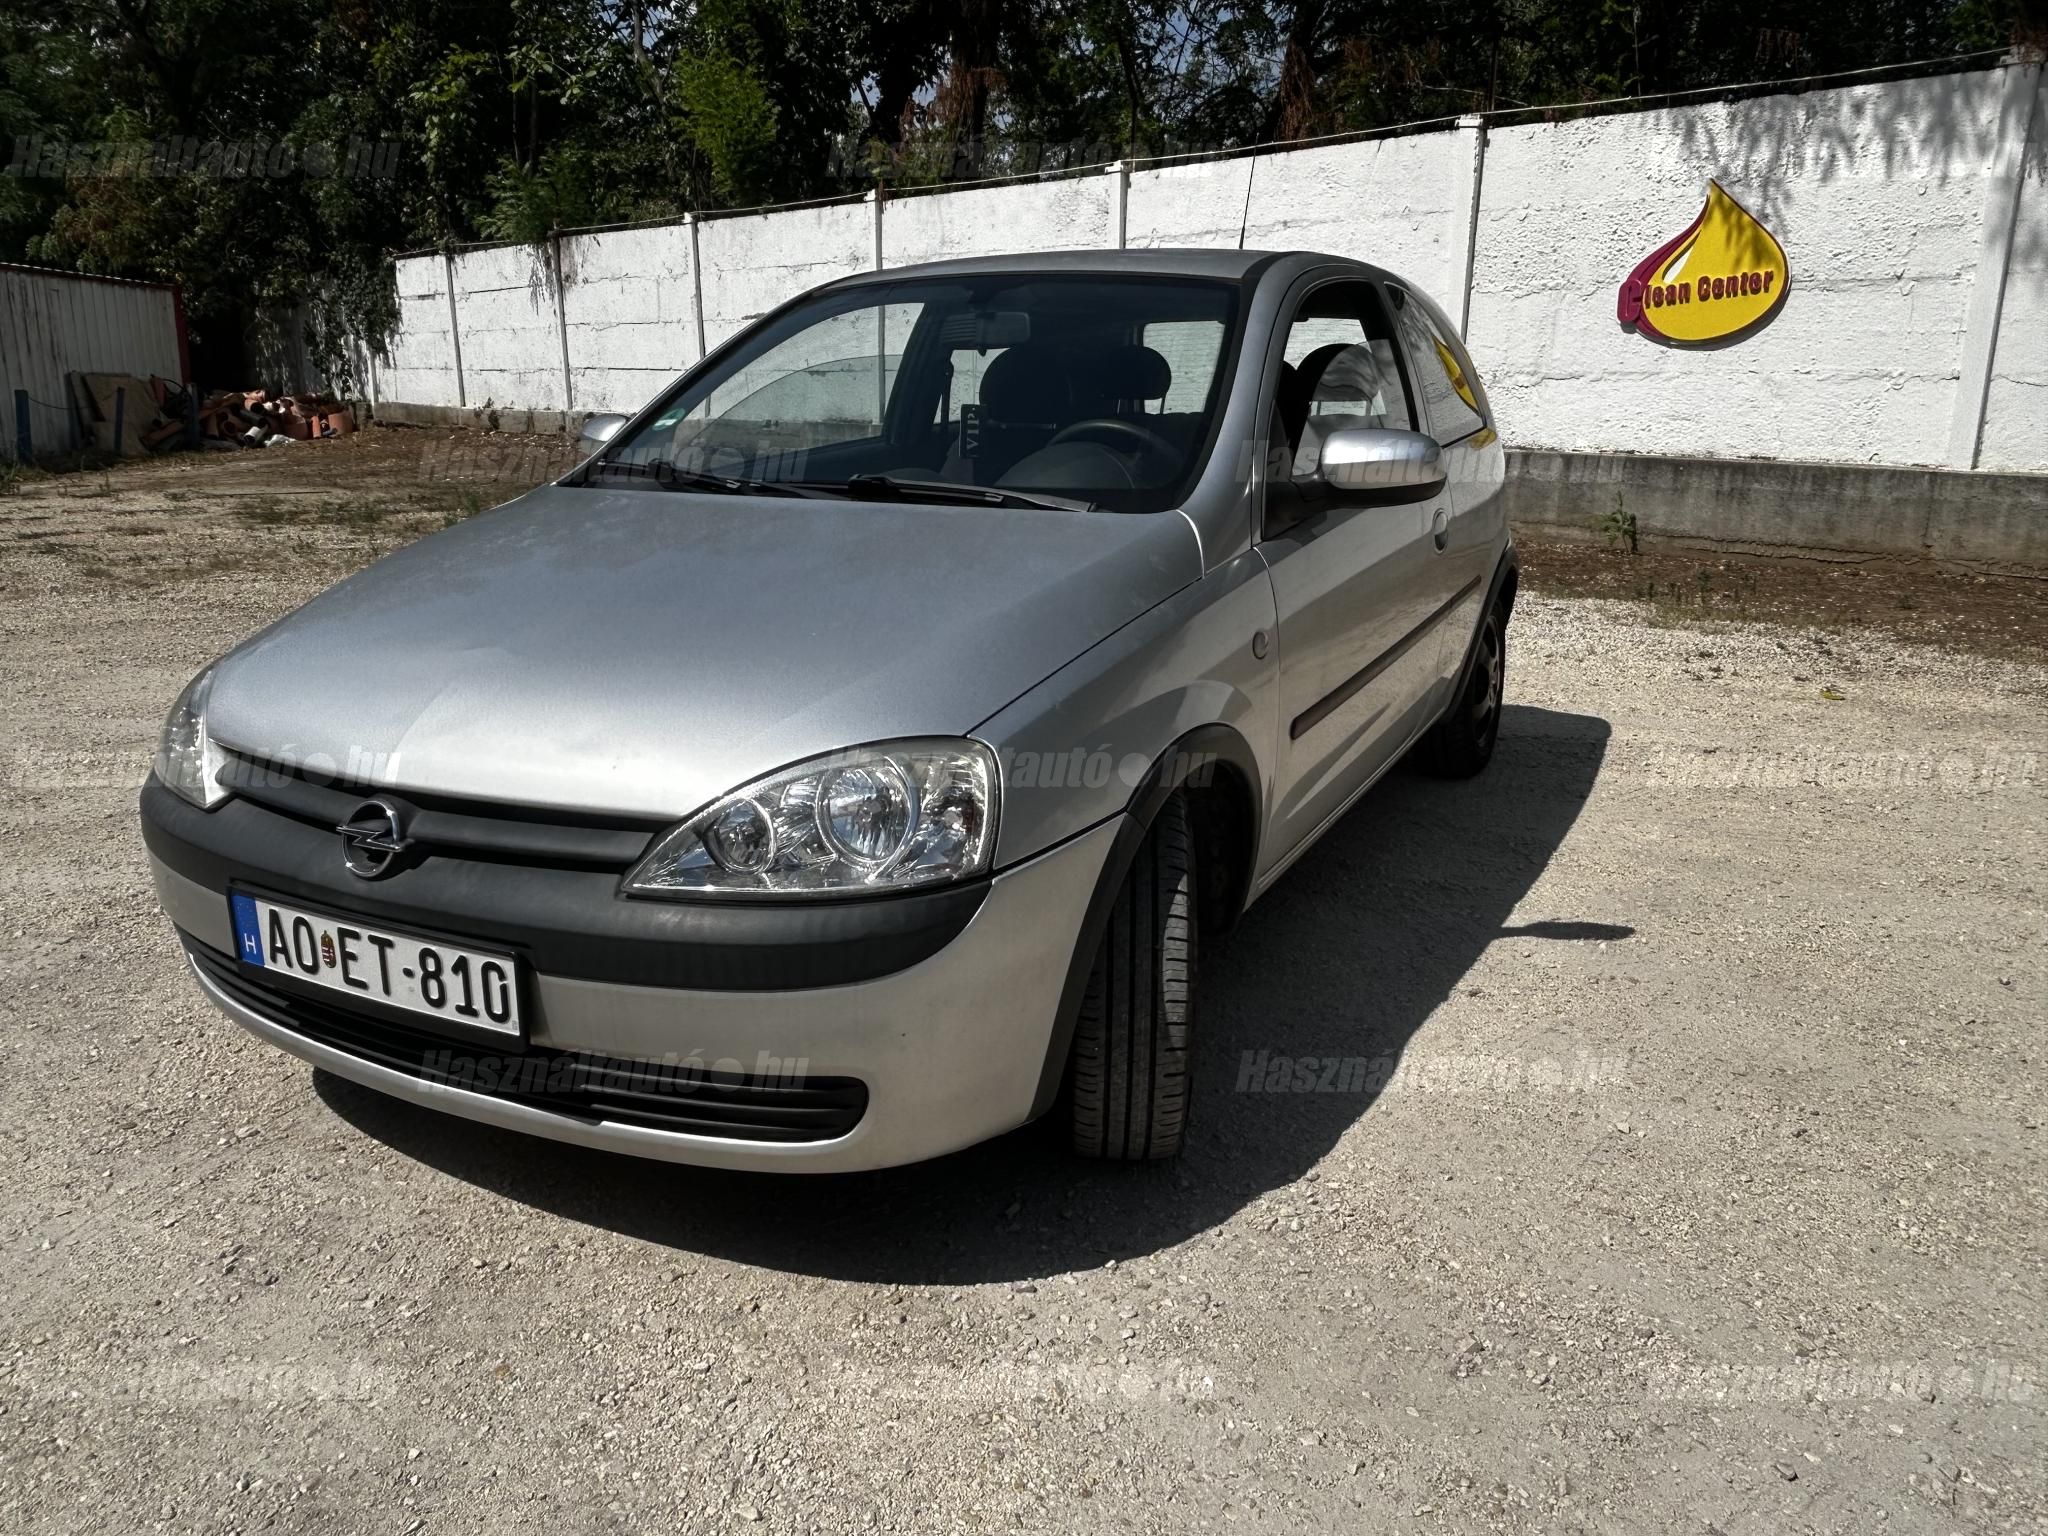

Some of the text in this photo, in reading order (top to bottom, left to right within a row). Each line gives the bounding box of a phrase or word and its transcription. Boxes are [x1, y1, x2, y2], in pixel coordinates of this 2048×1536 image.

[1617, 270, 1774, 325] Clean Center
[244, 933, 257, 955] H
